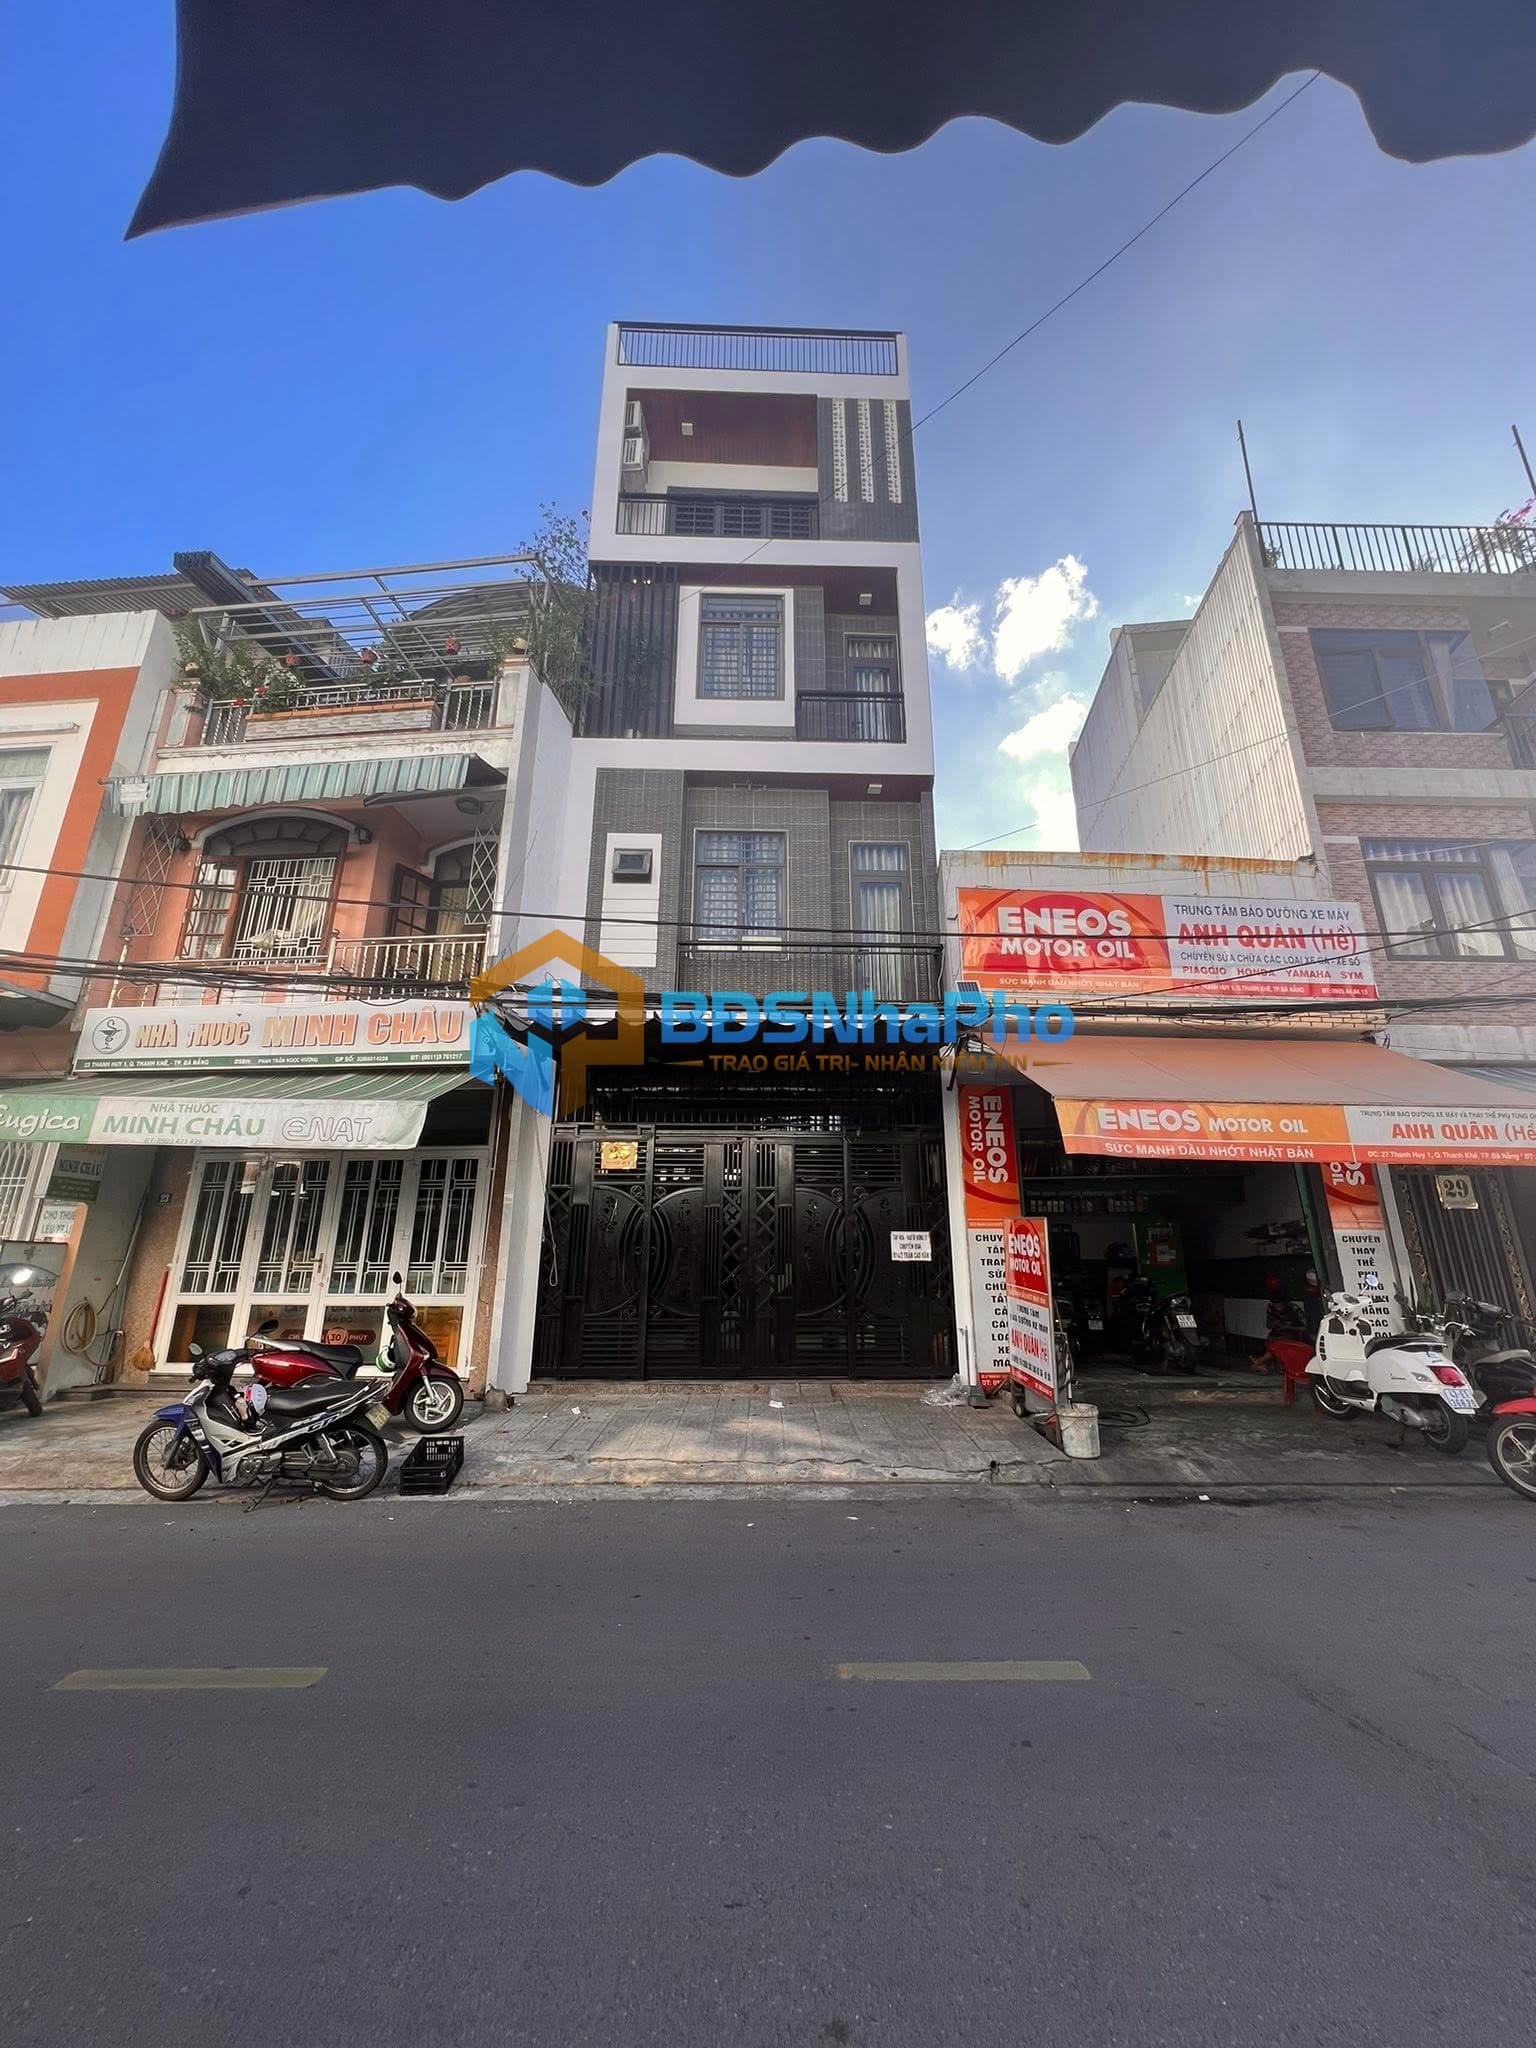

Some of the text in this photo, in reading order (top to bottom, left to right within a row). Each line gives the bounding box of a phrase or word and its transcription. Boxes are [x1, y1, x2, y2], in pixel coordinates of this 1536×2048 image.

[997, 906, 1132, 936] ENEOS
[1174, 904, 1350, 921] TRUNG TÂM BẢO DƯỠNG XE MÁY
[1178, 922, 1229, 947] ANH
[1236, 922, 1307, 949] QUÂN
[1000, 937, 1136, 959] MOTOR OIL
[1180, 951, 1215, 962] CHUYÊN
[1237, 952, 1262, 963] CHỮA
[1264, 952, 1281, 964] CÁC
[1283, 955, 1303, 966] LOẠI
[1337, 957, 1348, 966] XE
[999, 977, 1018, 985] SỨC
[1182, 966, 1364, 980] PIAGGIO HONDA YAMAHA SYM
[135, 1019, 179, 1049] NHÀ
[261, 1013, 359, 1048] MINH
[367, 1005, 465, 1046] CHÂU
[150, 1101, 218, 1114] NHÀ THUỐC
[103, 1113, 265, 1136] MINH CHÂU
[1097, 1107, 1308, 1135] ENEOS MOTOR OIL
[968, 1096, 986, 1184] MOTOR OIL
[983, 1095, 1008, 1184] ENEOS
[1391, 1123, 1435, 1140] ANH
[1440, 1121, 1499, 1141] QUÂN
[1105, 1139, 1314, 1161] SỨC MẠNH DẦU NHỚT NHẬT BẢN
[1443, 1179, 1469, 1198] 29
[975, 1234, 1003, 1242] CHUY
[1008, 1232, 1041, 1259] ENEOS
[1341, 1234, 1381, 1243] CHUYÊN
[1351, 1247, 1376, 1255] THAY
[1010, 1258, 1042, 1277] MOTOR OIL
[329, 1333, 342, 1342] 30
